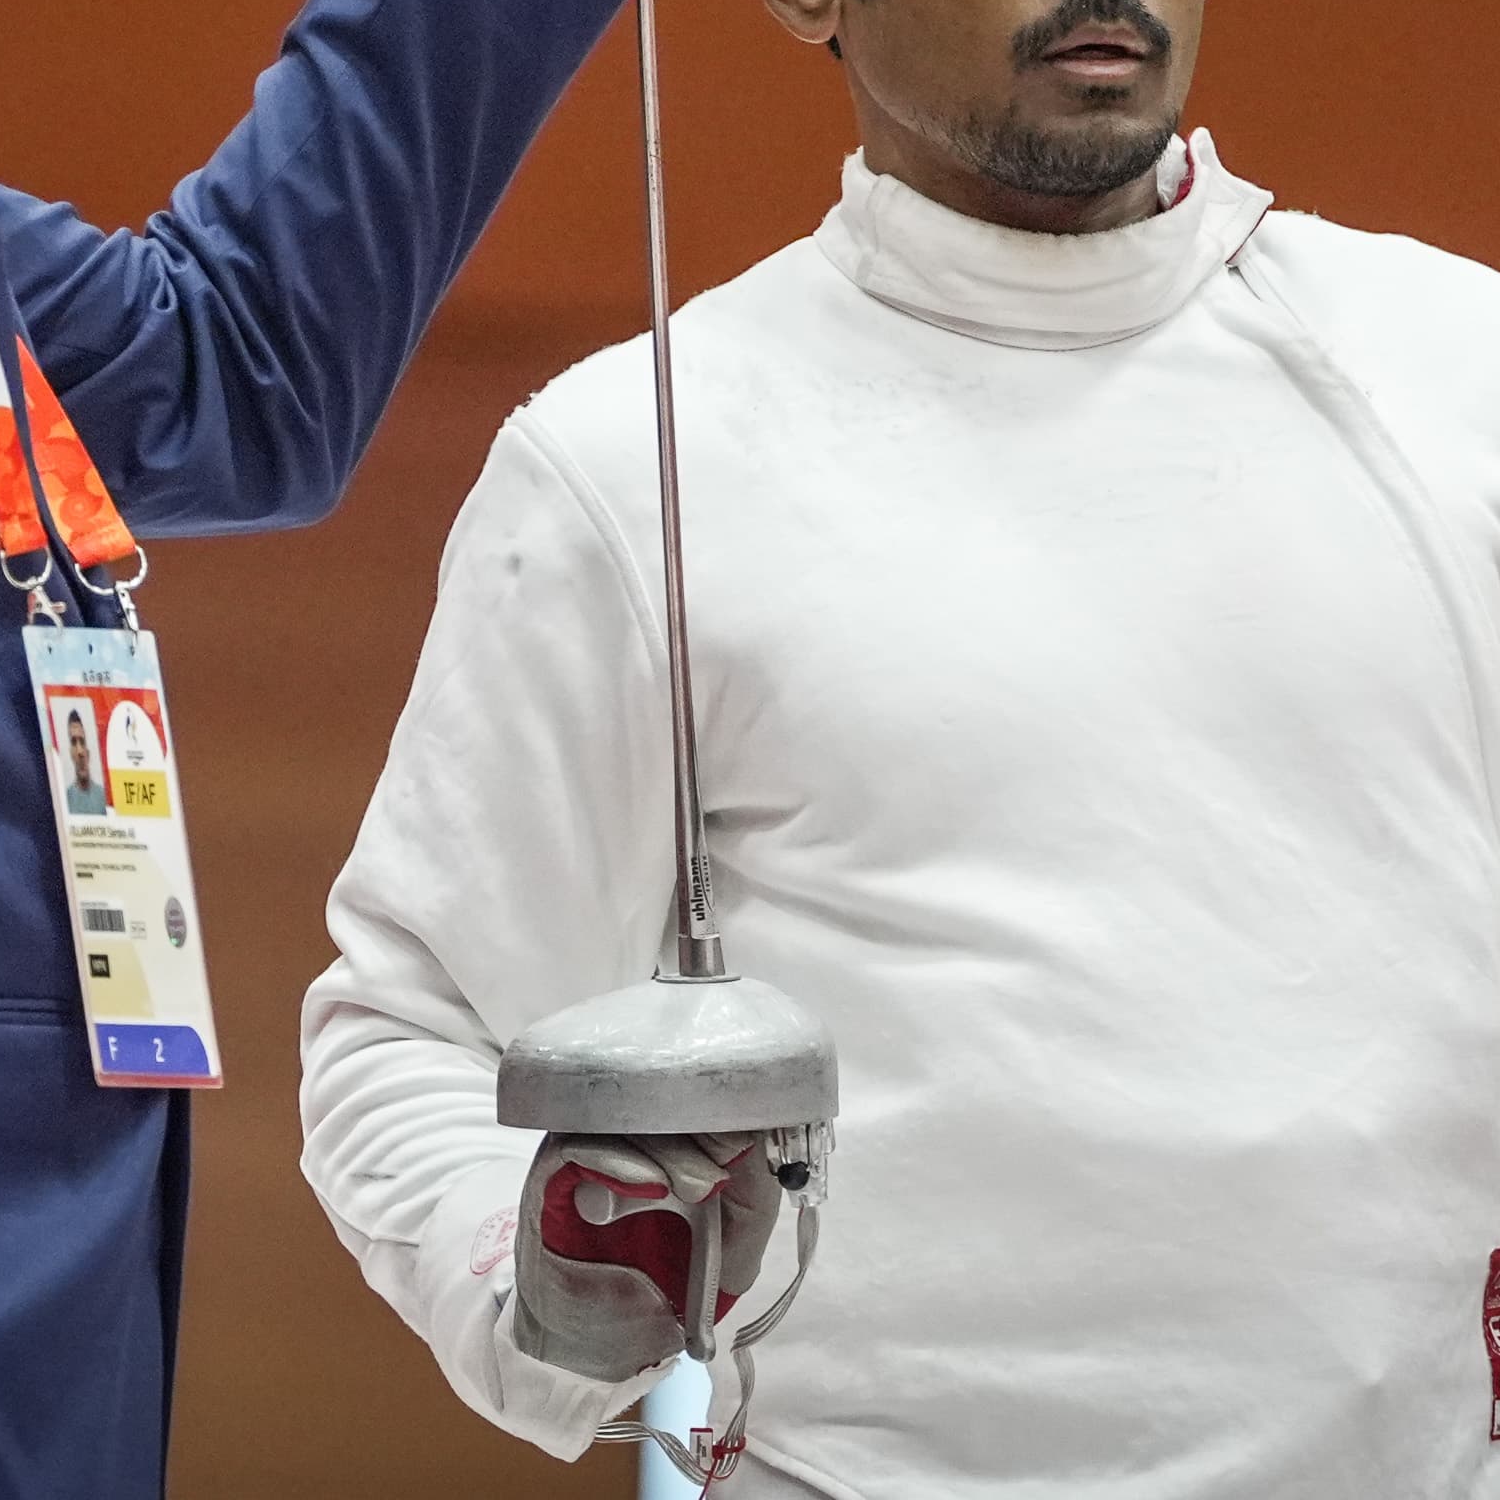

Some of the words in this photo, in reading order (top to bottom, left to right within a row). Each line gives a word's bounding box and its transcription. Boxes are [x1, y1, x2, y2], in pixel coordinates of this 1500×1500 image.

[691, 857, 705, 921] uhlmann
[108, 1036, 118, 1061] F
[153, 1036, 165, 1063] 2
